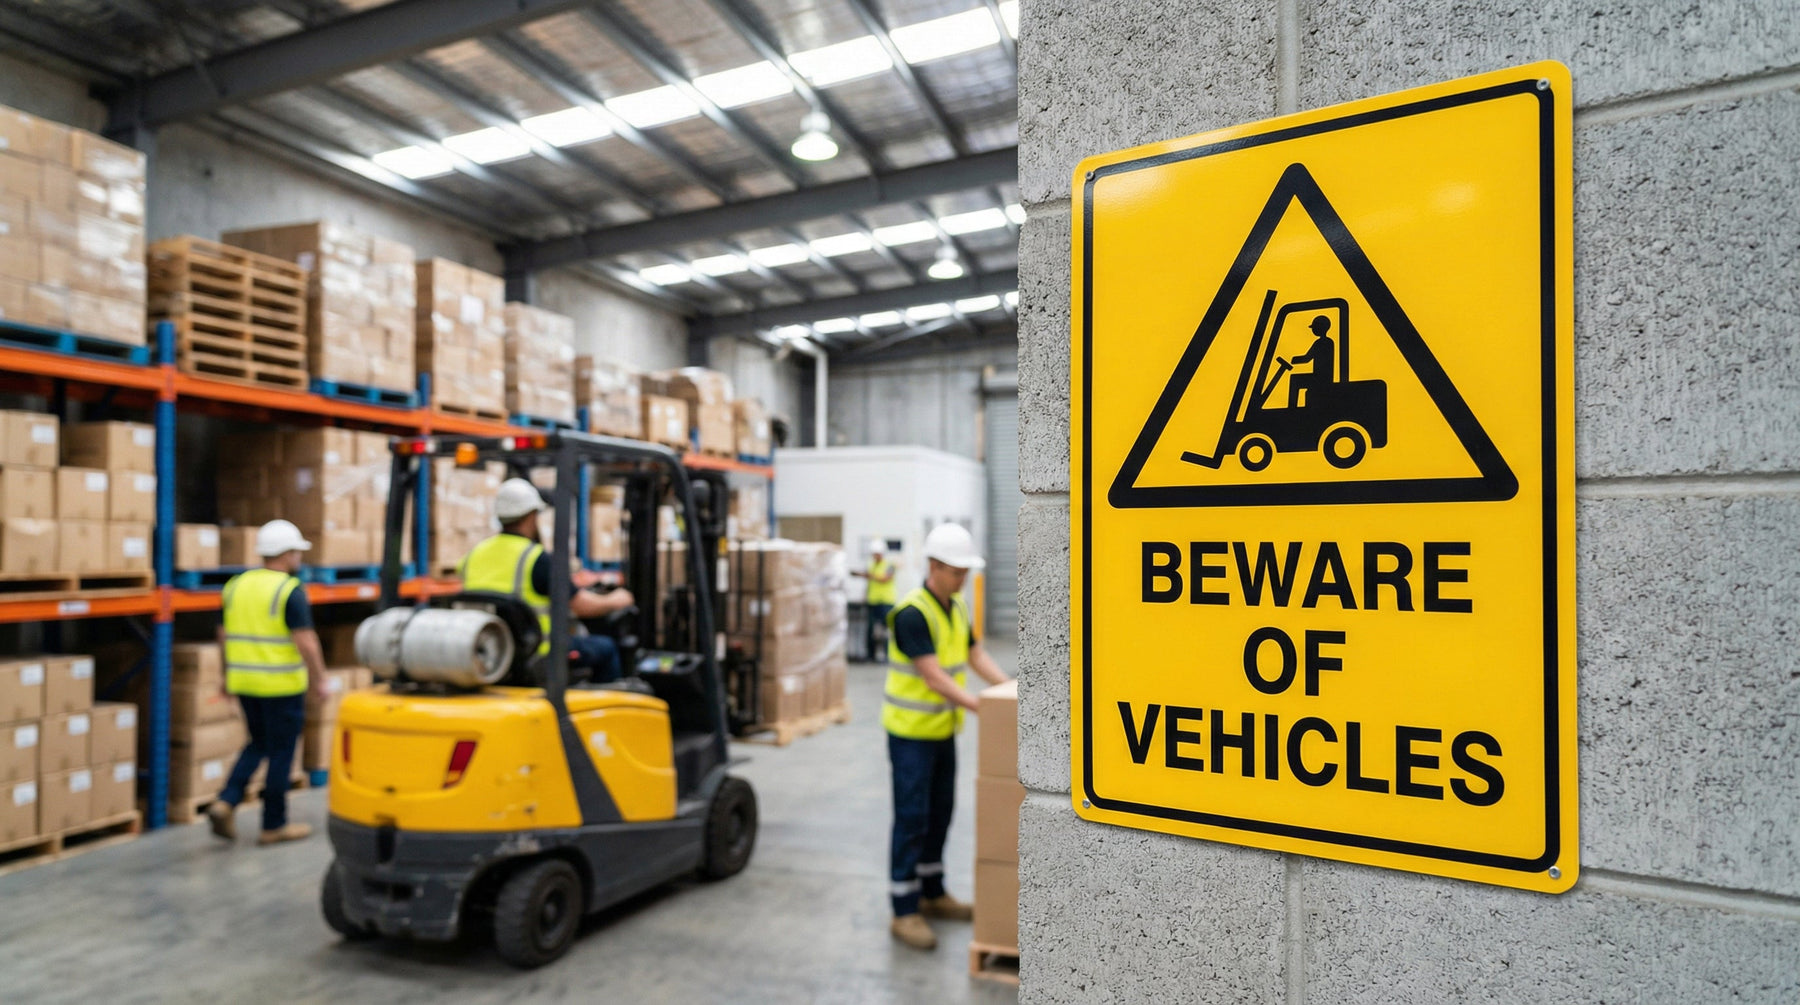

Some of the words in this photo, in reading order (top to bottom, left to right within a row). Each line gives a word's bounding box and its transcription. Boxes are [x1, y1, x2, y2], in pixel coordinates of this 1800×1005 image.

[1141, 541, 1473, 614] BEWARE
[1243, 626, 1346, 697] OF
[1117, 701, 1505, 807] VEHICLES
